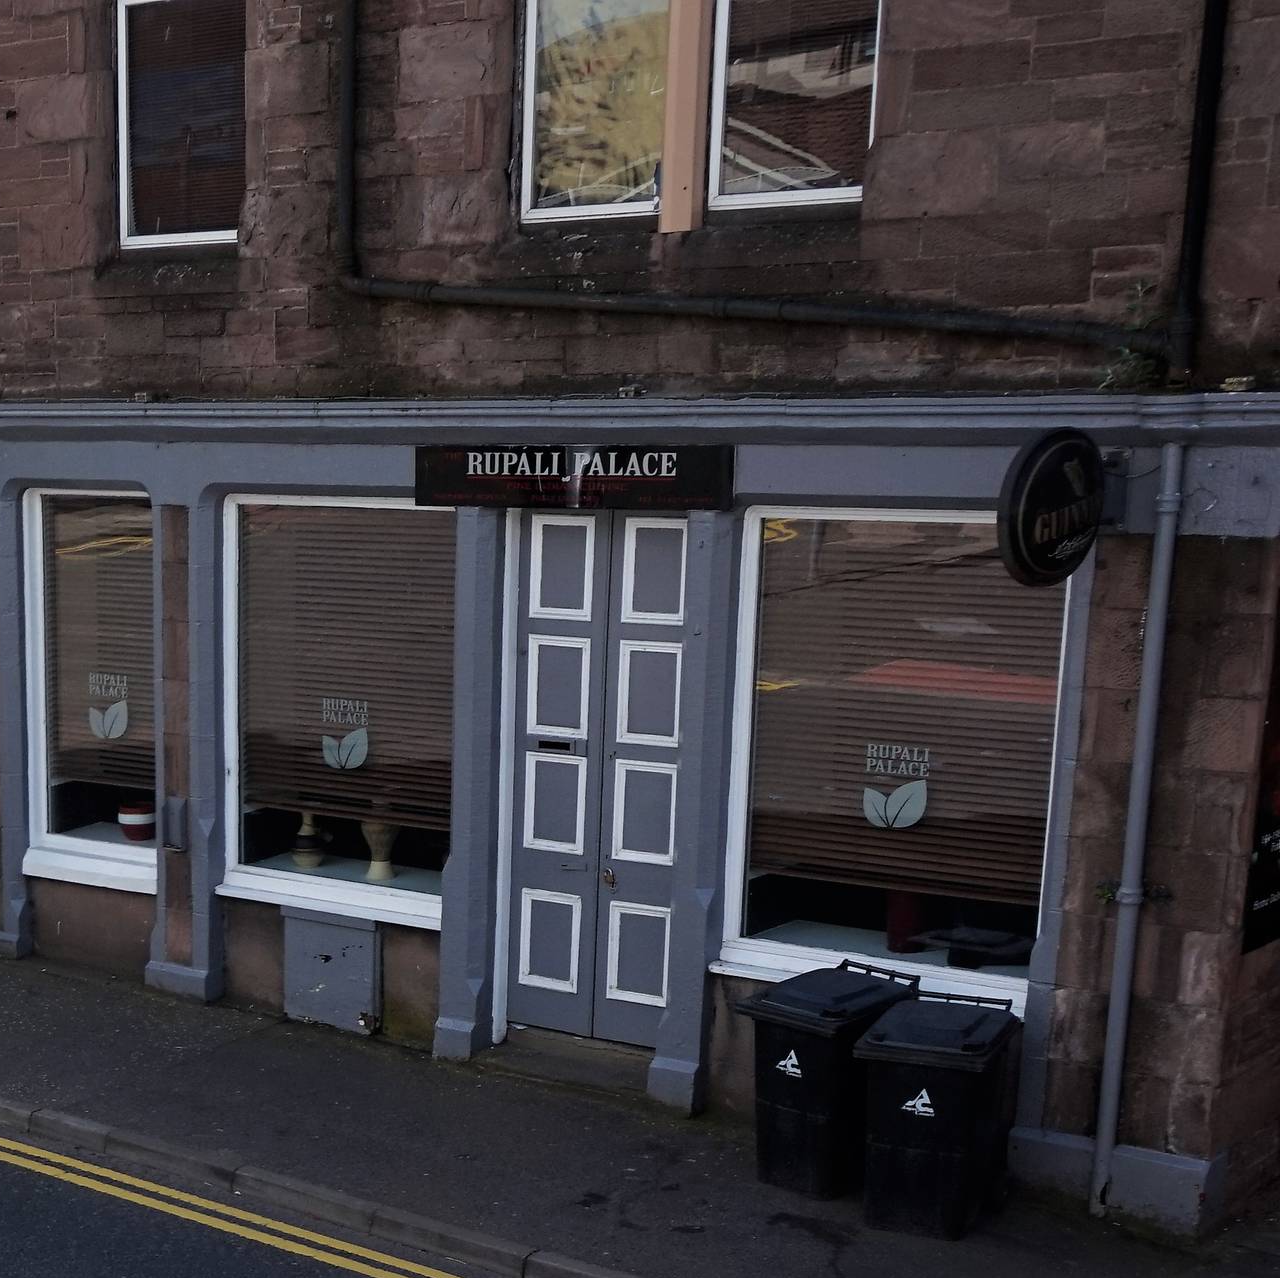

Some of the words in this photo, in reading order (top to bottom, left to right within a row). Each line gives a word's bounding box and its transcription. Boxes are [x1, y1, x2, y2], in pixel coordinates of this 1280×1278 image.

[466, 452, 561, 476] RUPALI
[573, 452, 677, 477] PALACE
[89, 672, 128, 686] RUPALI
[89, 684, 129, 698] PALACE
[322, 698, 368, 712] RUPALI
[322, 710, 369, 725] PALACE
[867, 744, 930, 762] RUPALI
[866, 758, 930, 777] PALACE
